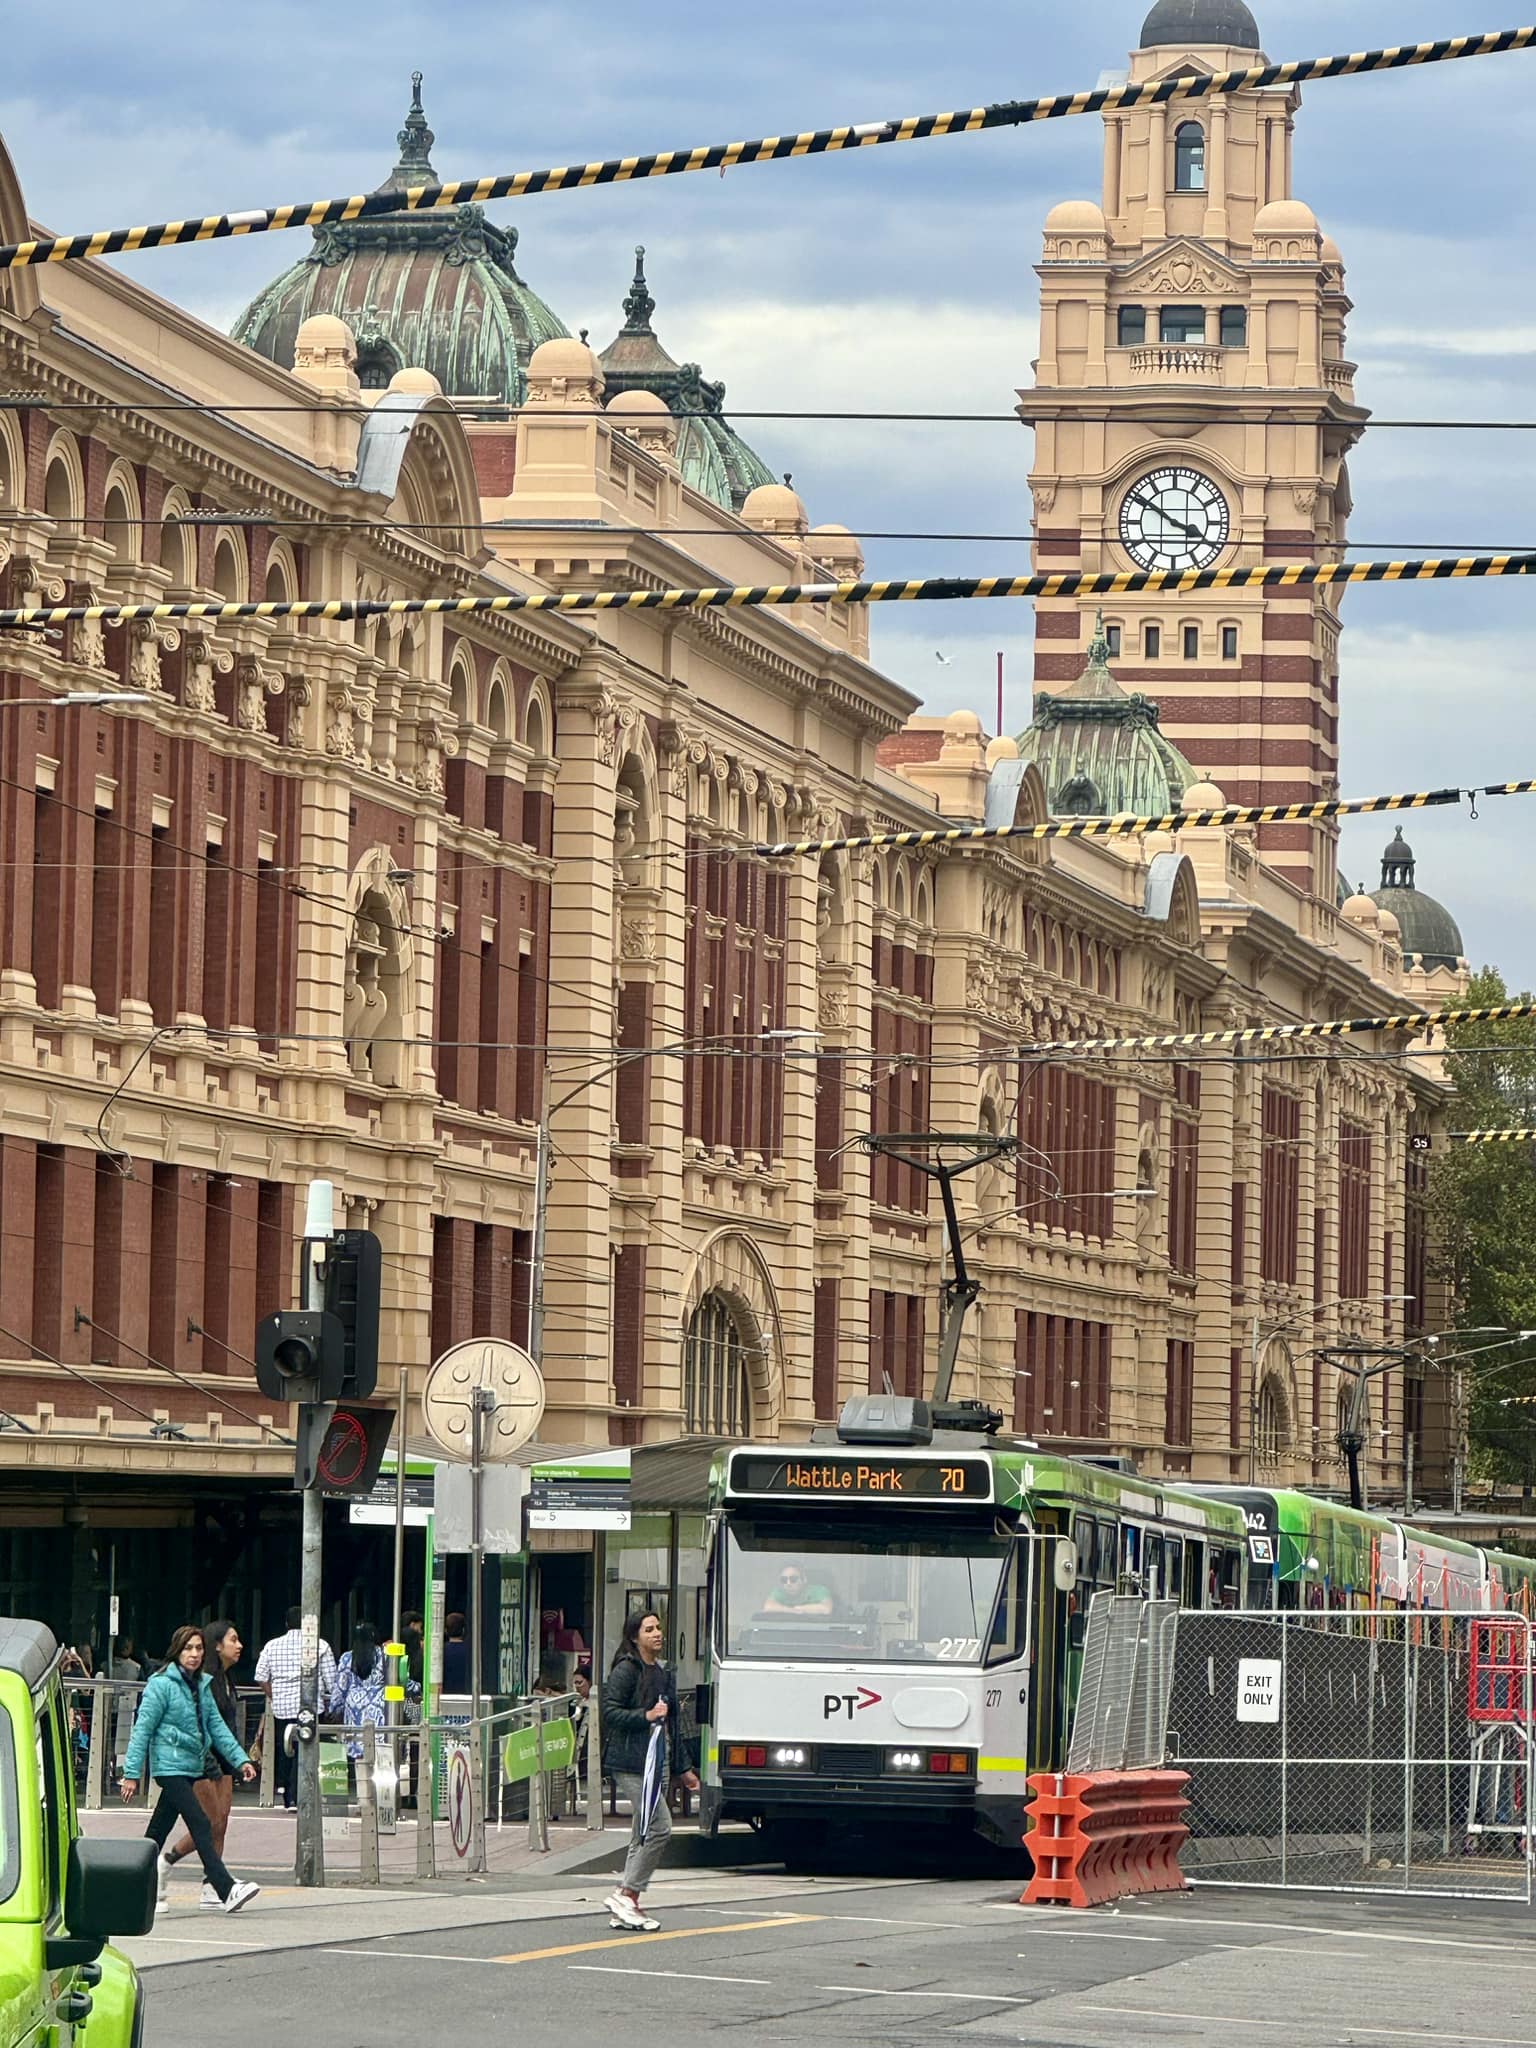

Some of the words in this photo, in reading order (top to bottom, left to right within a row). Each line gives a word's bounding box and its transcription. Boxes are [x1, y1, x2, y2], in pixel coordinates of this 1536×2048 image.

[1413, 1137, 1428, 1148] 35
[786, 1464, 852, 1489] Wattle
[856, 1466, 903, 1490] Park
[940, 1468, 965, 1491] 70
[935, 1637, 981, 1659] 277
[1246, 1675, 1273, 1688] EXIT
[986, 1690, 1001, 1707] 277
[1243, 1692, 1273, 1706] ONLY
